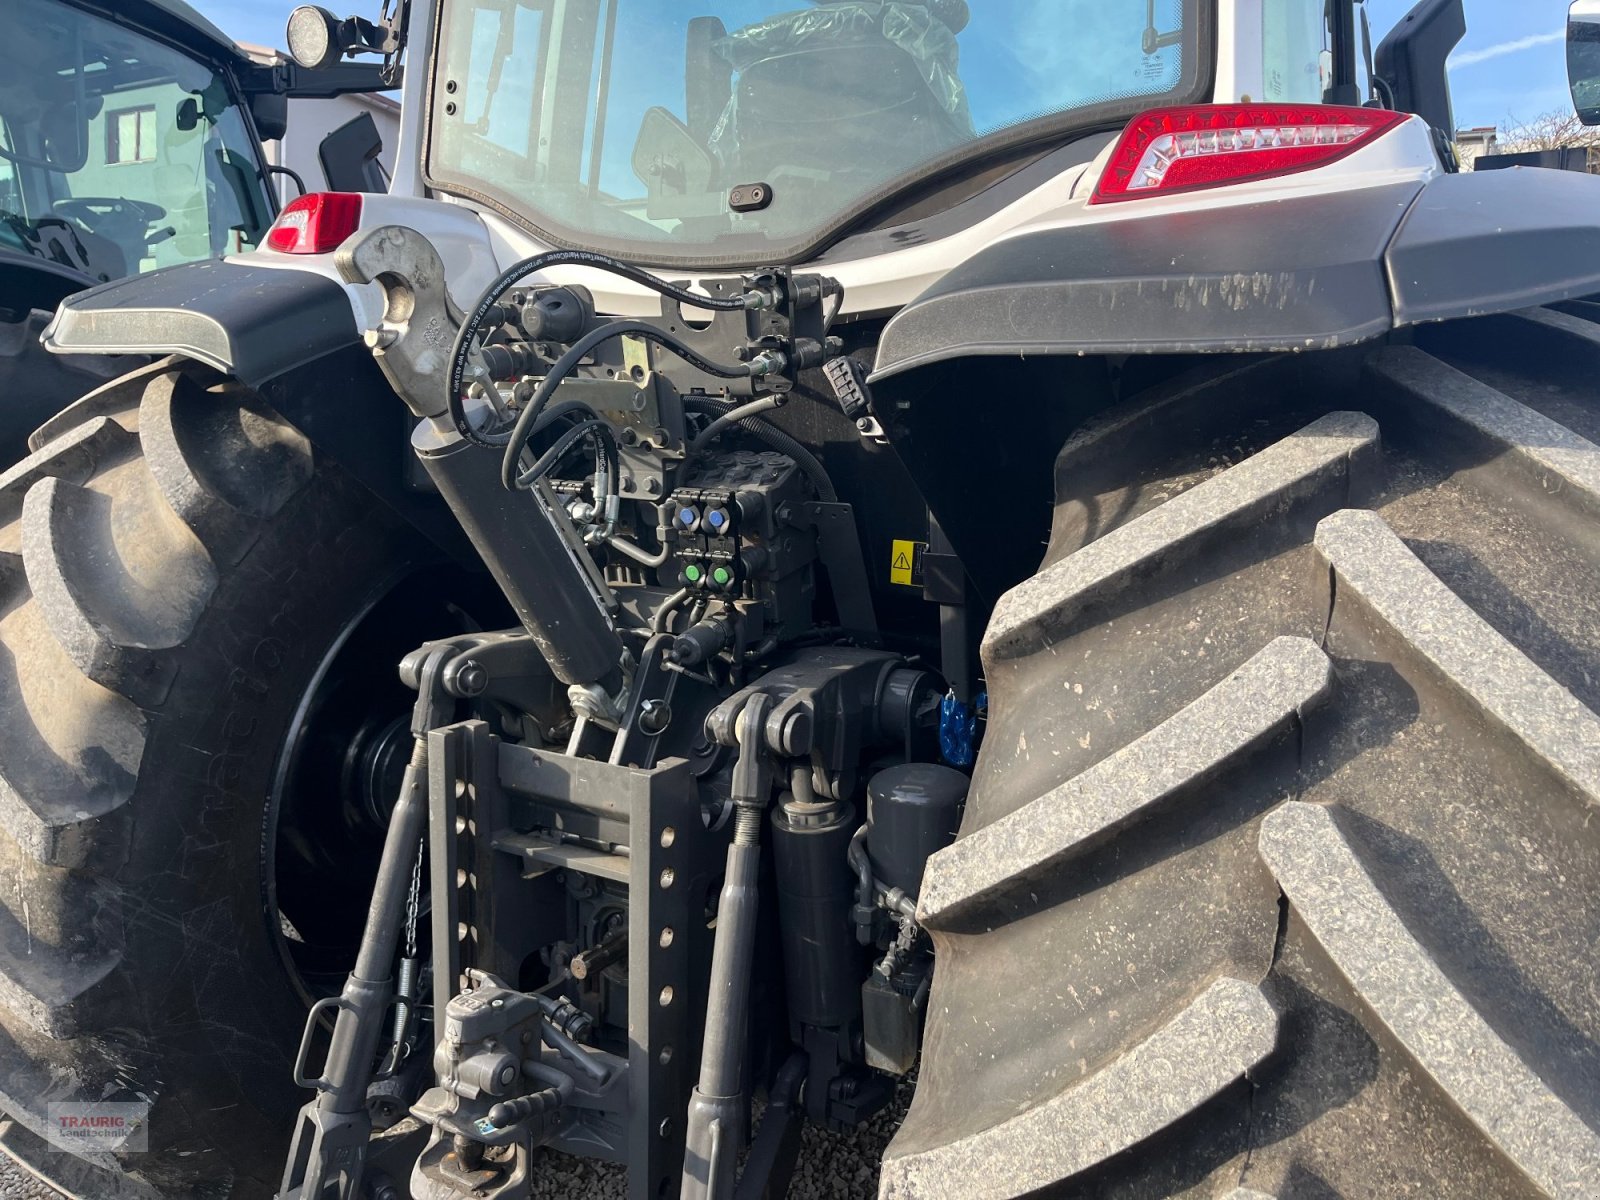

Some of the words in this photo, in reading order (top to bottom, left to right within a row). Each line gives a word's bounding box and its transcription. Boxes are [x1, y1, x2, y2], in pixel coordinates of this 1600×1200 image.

[547, 251, 580, 262] HardCover
[492, 277, 512, 296] Exceeds
[459, 341, 469, 356] Max
